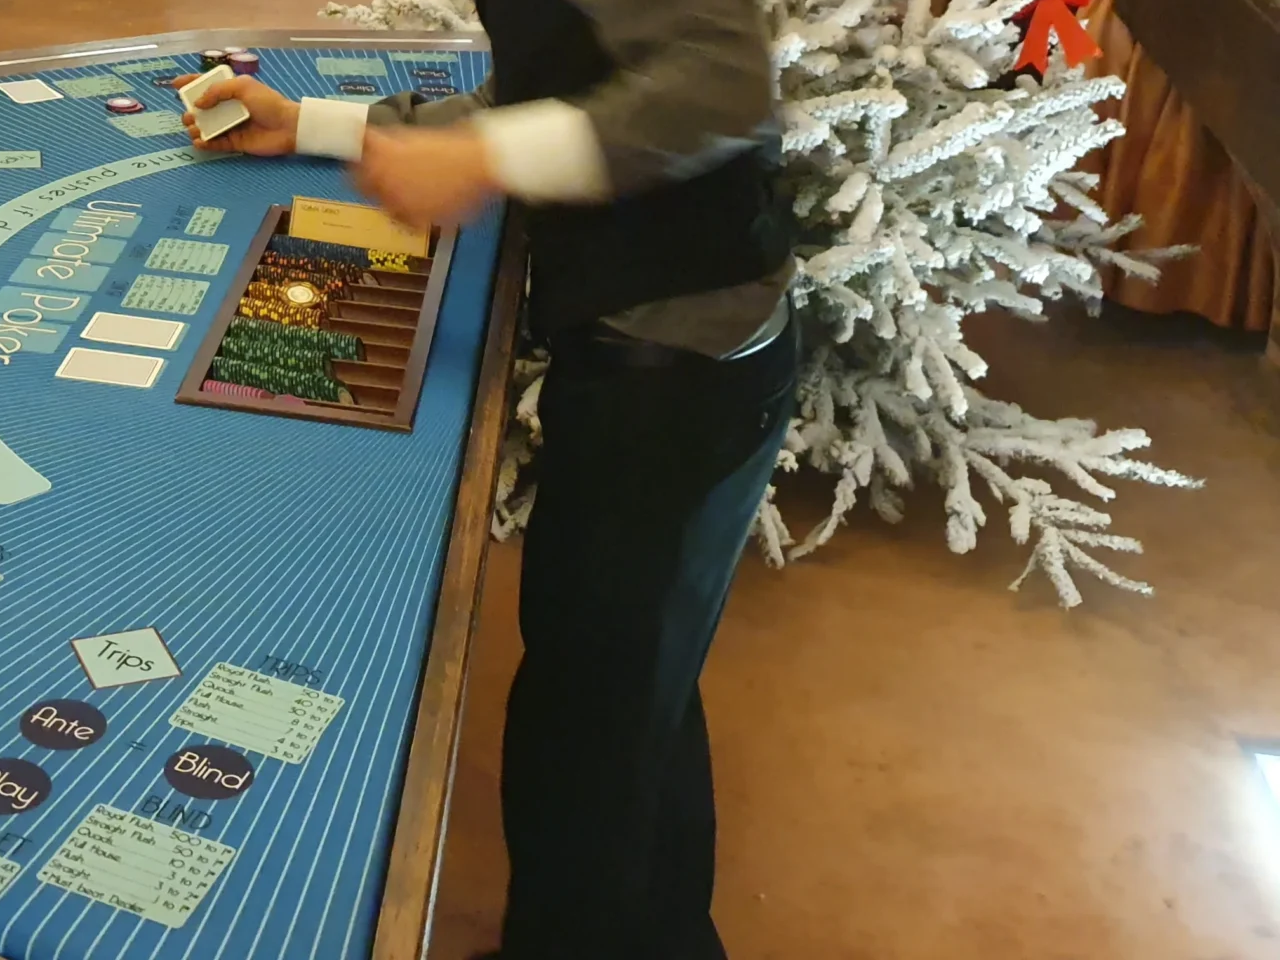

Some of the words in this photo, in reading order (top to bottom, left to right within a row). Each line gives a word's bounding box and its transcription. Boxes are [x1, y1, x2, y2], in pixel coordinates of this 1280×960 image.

[131, 152, 195, 168] Ante
[39, 167, 118, 201] pushes
[13, 206, 38, 217] if
[37, 200, 143, 280] Ultimate
[97, 640, 155, 672] Trips
[218, 664, 245, 677] Royal
[247, 671, 270, 685] Flush
[258, 655, 323, 685] TRIPS
[202, 680, 235, 696] Quads
[209, 672, 246, 687] Straight
[252, 684, 273, 696] Flush
[188, 698, 210, 710] Flush
[196, 688, 212, 698] Full
[215, 695, 244, 709] House
[31, 706, 95, 740] Ante
[173, 714, 194, 729] Trips
[180, 705, 218, 724] Straight
[174, 751, 250, 790] Blind
[140, 796, 212, 830] BLIND
[77, 827, 113, 845] Quads
[85, 816, 127, 835] Straight
[130, 830, 156, 846] Flush
[172, 845, 193, 857] 50
[95, 806, 124, 821] Royal
[129, 815, 154, 832] Flush
[170, 831, 202, 846] 500
[58, 848, 84, 864] Flush
[66, 837, 86, 850] Full
[89, 843, 121, 862] House
[48, 858, 91, 880] Straight
[109, 895, 146, 914] Dealer
